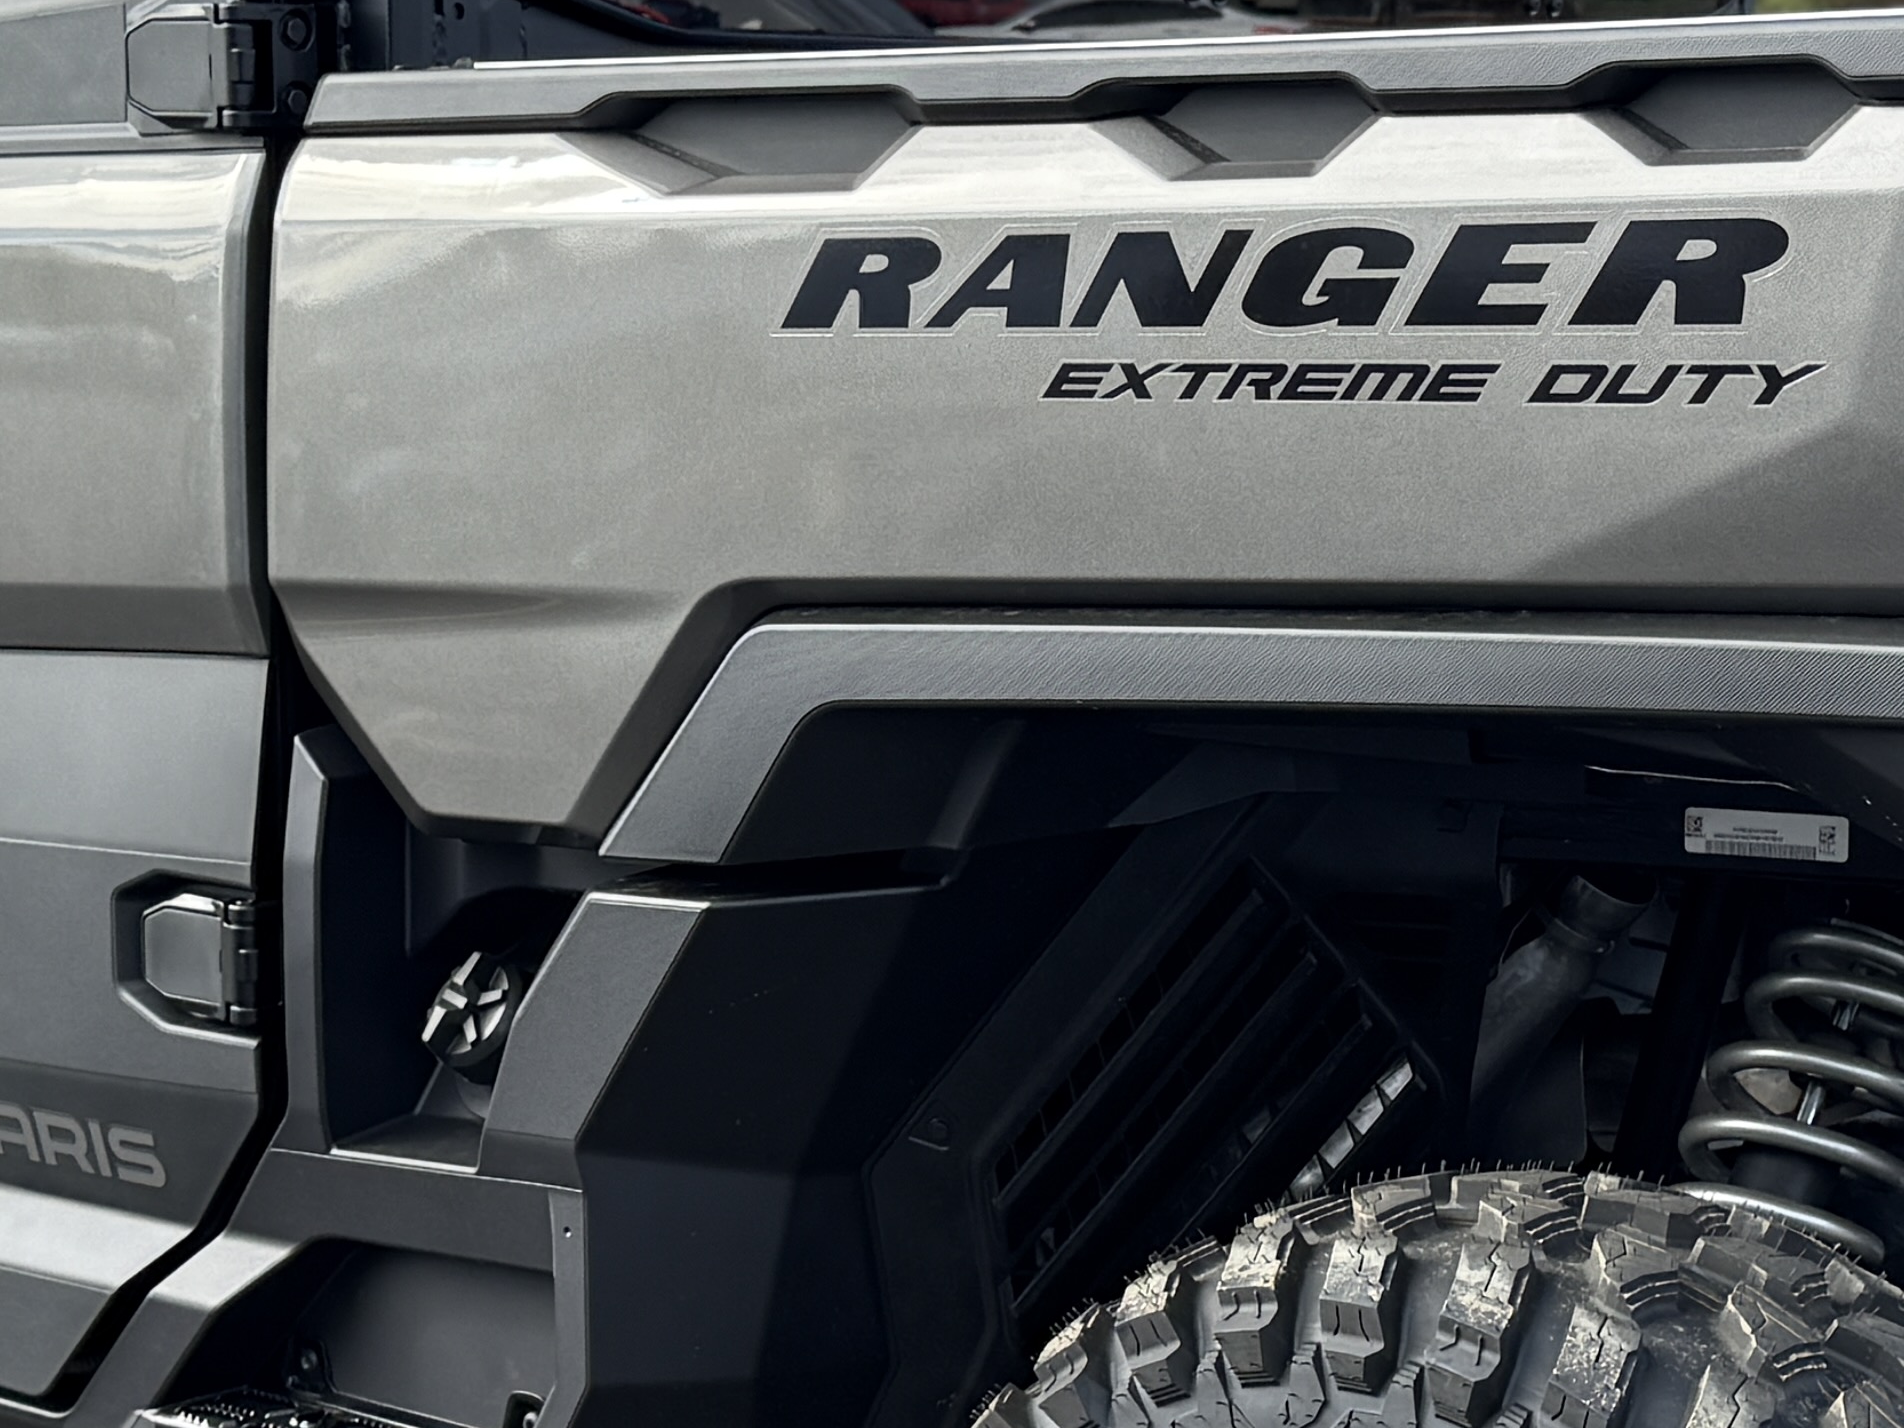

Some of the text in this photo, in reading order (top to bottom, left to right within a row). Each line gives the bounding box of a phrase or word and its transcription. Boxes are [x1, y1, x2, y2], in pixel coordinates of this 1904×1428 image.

[781, 217, 1791, 330] RANGER
[1039, 362, 1827, 405] EXTREME DUTY
